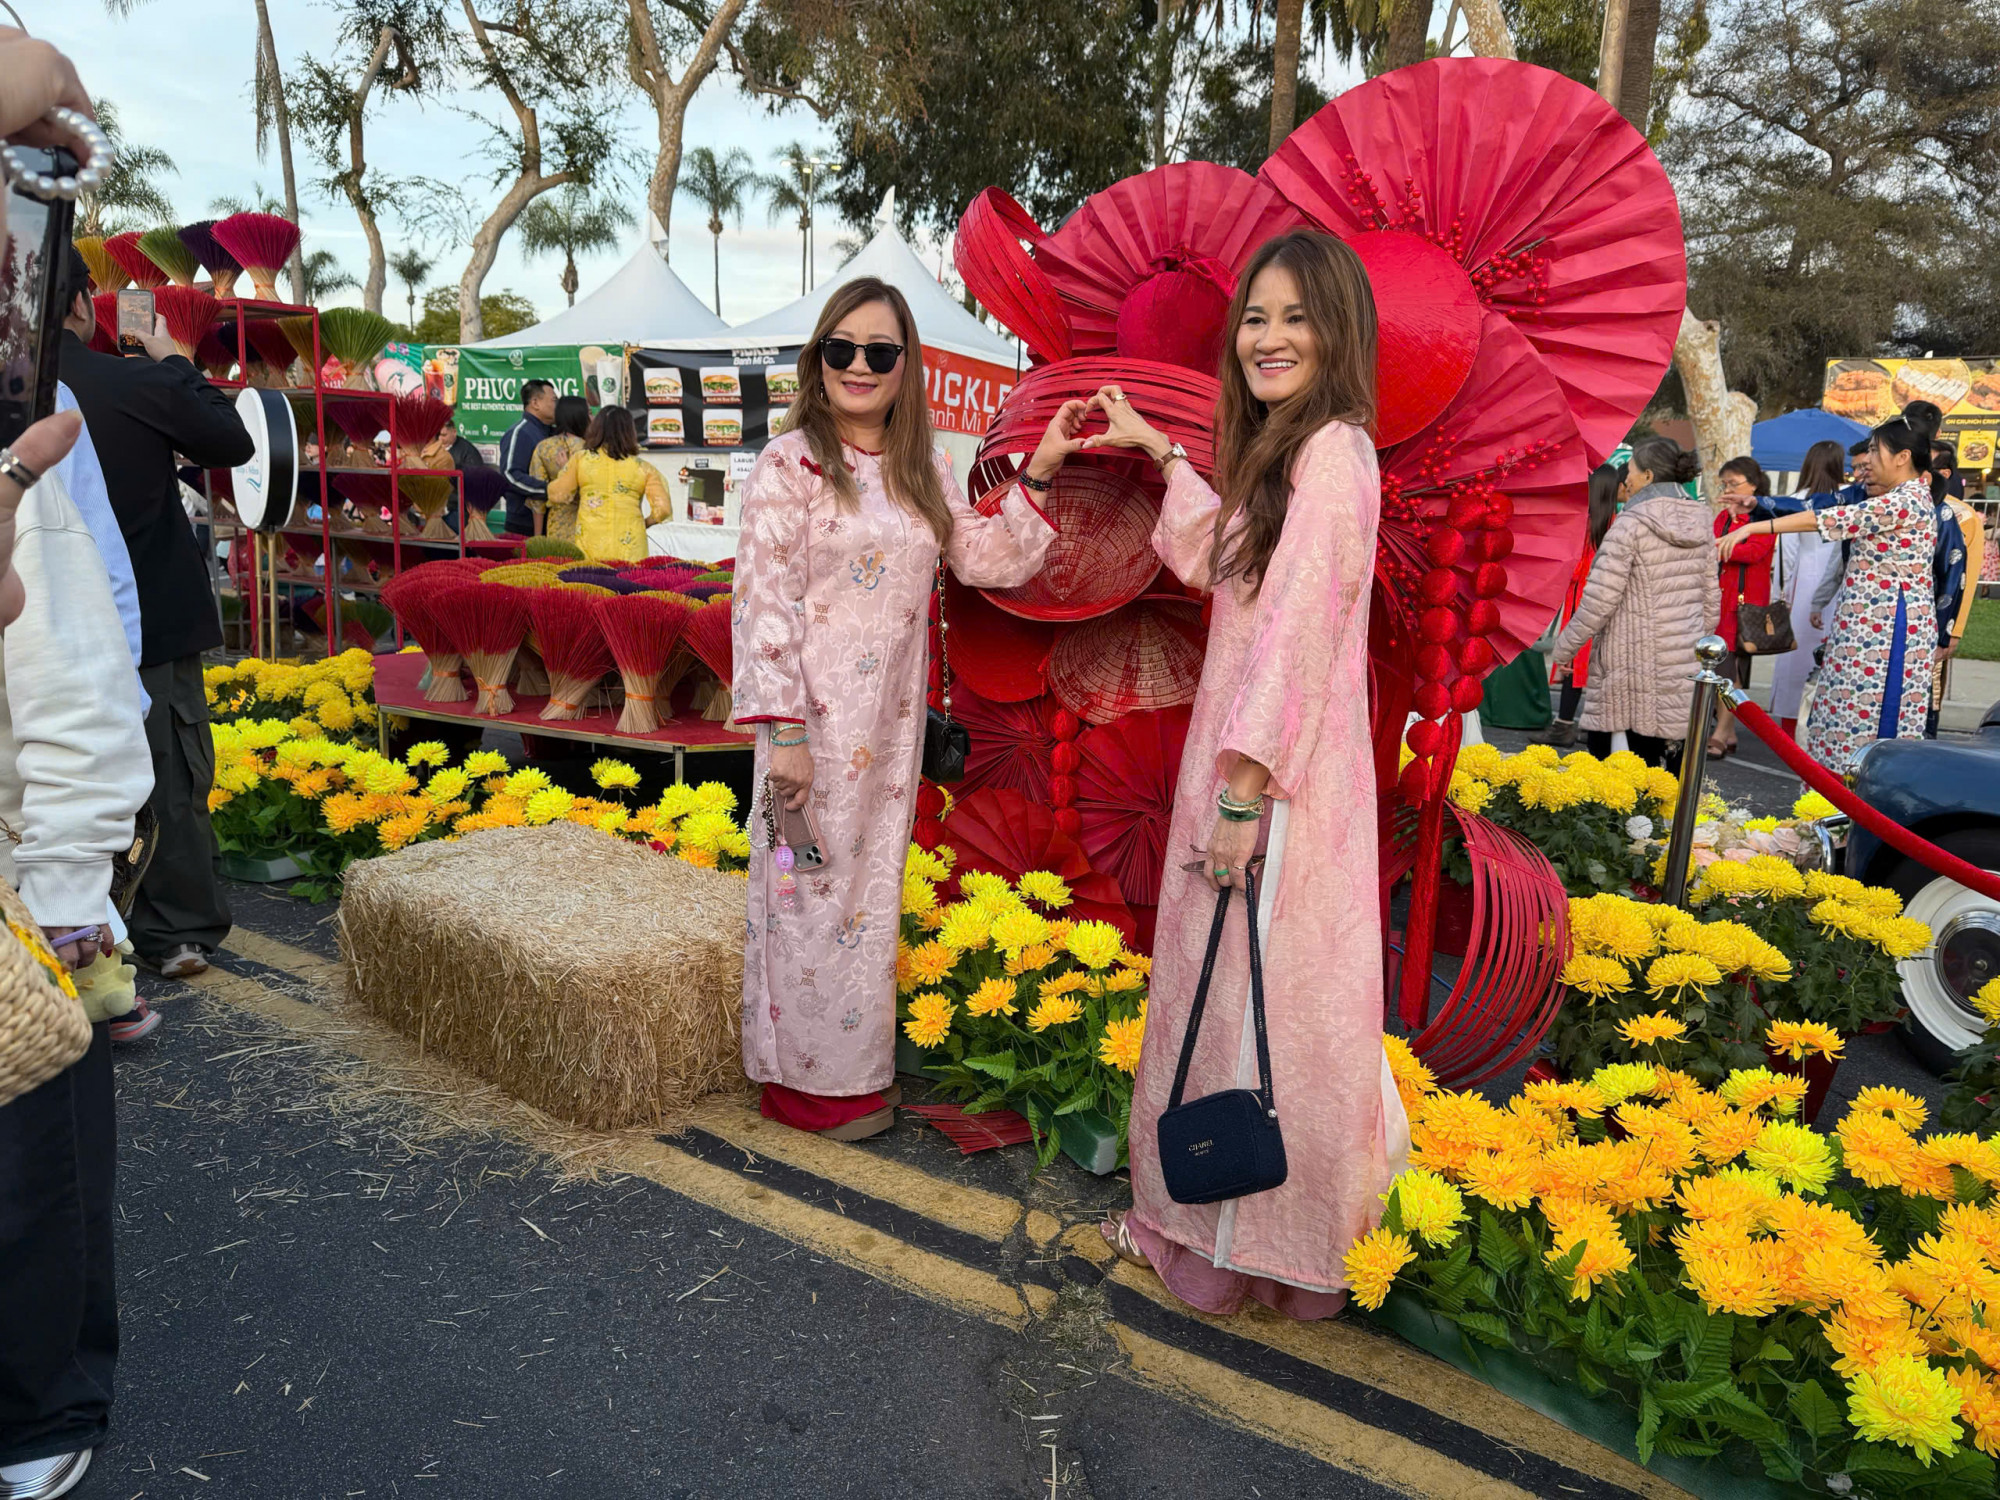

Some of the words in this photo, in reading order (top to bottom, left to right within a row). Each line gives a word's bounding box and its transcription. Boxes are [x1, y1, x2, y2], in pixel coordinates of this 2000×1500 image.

[733, 356, 751, 365] Banh
[753, 356, 762, 365] Mi
[763, 356, 775, 364] Co.
[464, 377, 516, 400] PHUC
[521, 377, 579, 399] NG
[462, 402, 470, 410] THE
[929, 406, 955, 428] anh
[962, 409, 981, 432] Mi
